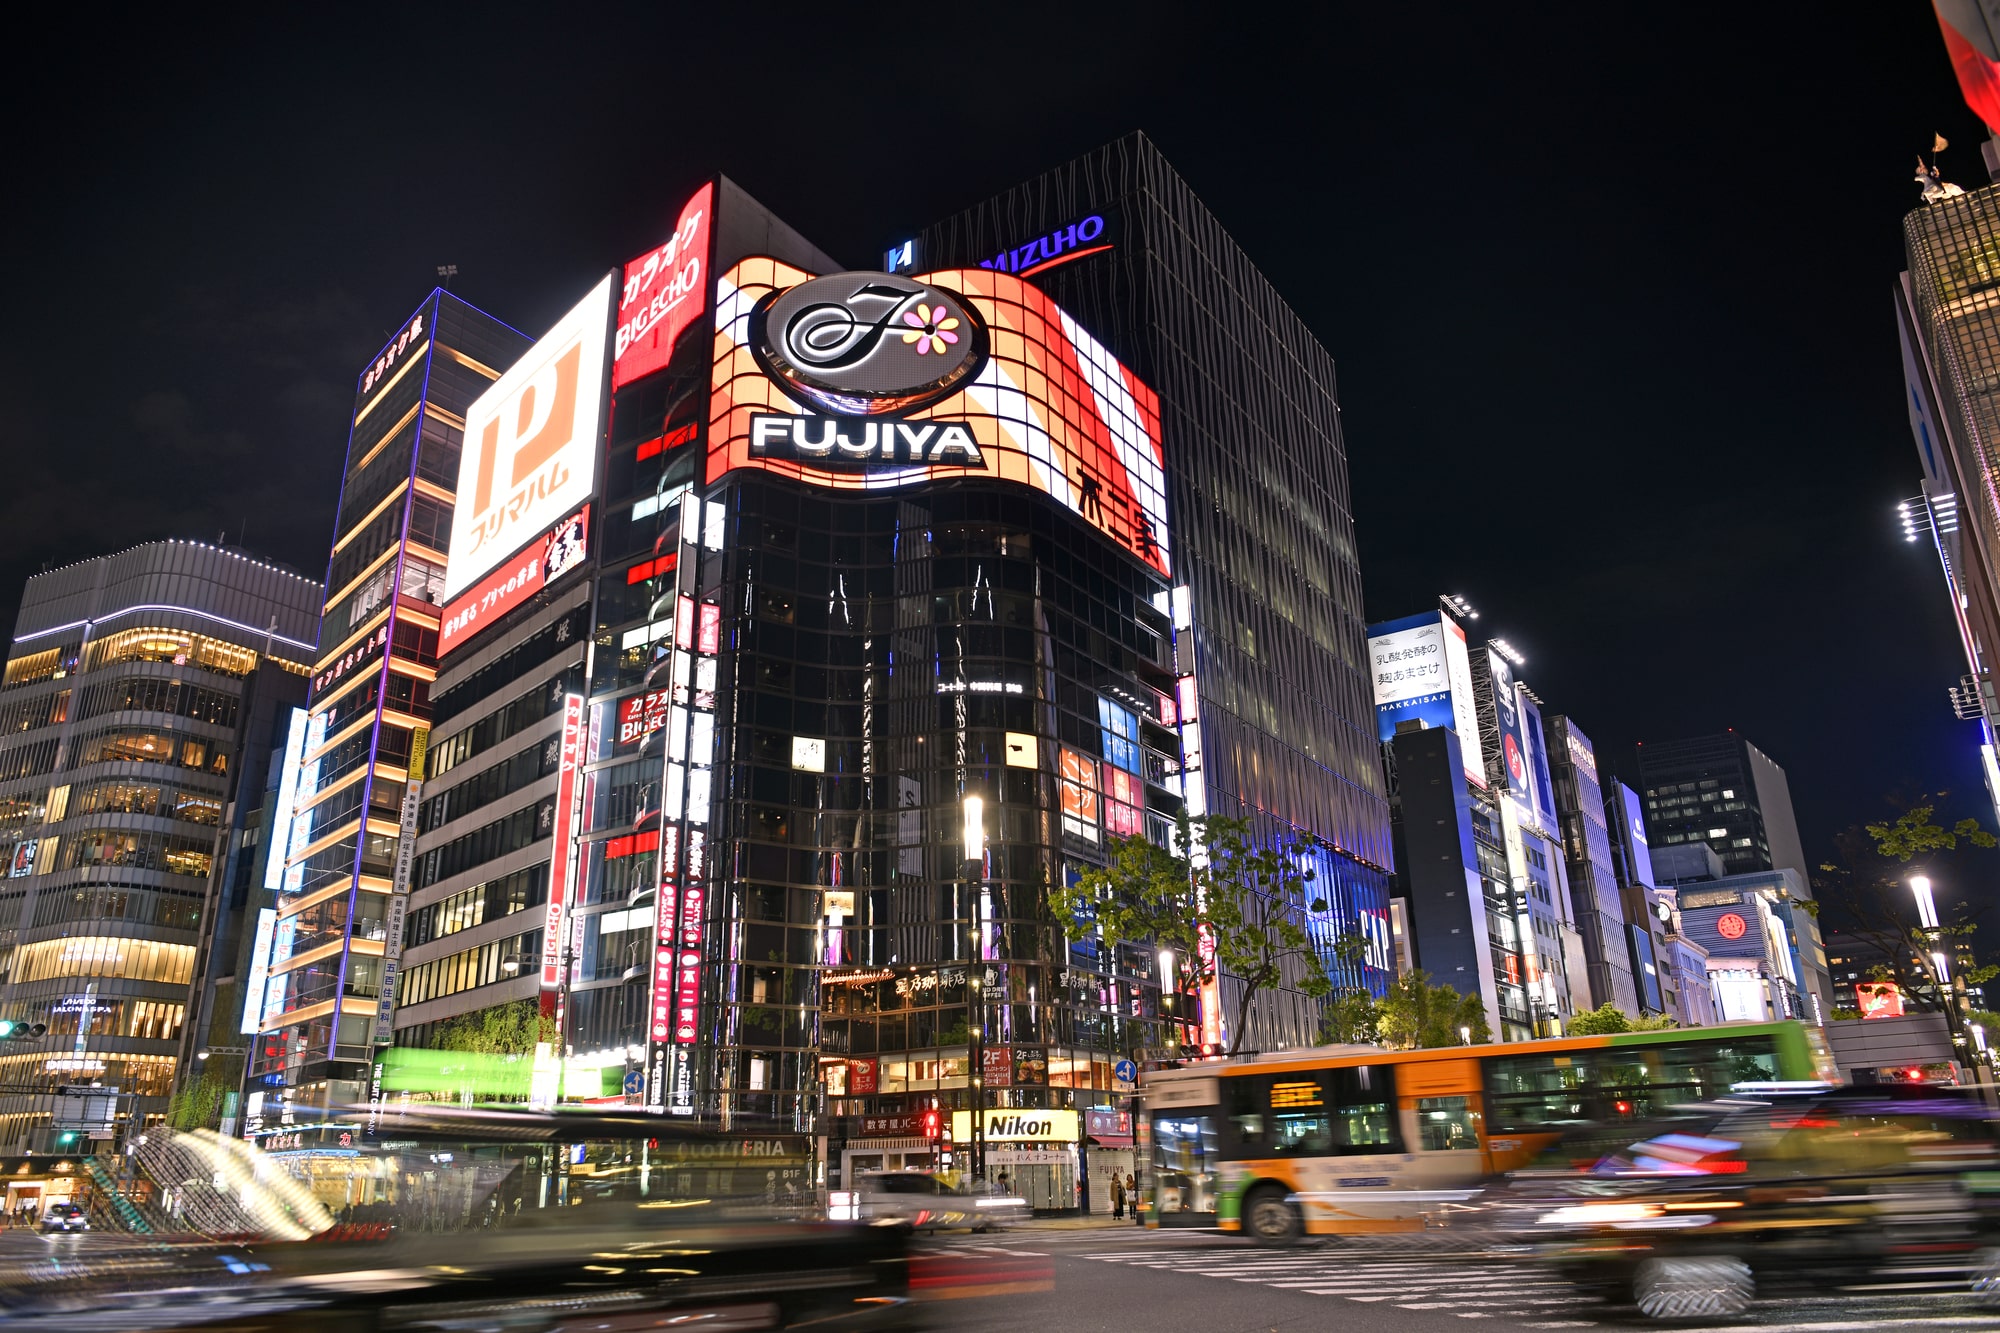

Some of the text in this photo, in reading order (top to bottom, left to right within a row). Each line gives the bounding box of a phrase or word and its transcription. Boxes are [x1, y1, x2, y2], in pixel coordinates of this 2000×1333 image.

[979, 215, 1104, 273] MIZUHO
[622, 210, 703, 311] カラオケ
[615, 257, 700, 361] BIG ECHO
[752, 417, 982, 460] FUJIYA
[469, 461, 569, 555] プリマハム
[1076, 466, 1158, 565] 不二家
[1375, 643, 1438, 666] 乳酸発酵の
[1377, 662, 1441, 685] 麹あまさけ
[631, 689, 668, 713] カラオ
[1380, 693, 1446, 712] HAKKAISAN
[650, 713, 666, 730] EC
[412, 731, 421, 768] BREITLING
[562, 705, 580, 773] カラオケ
[1360, 910, 1390, 972] GAP
[379, 963, 396, 1023] 五百住歯科
[656, 967, 669, 1020] 不二家
[895, 970, 967, 995] 星乃珈琲店
[1060, 971, 1104, 994] 星乃珈琲店
[1779, 979, 1791, 1017] MITSUKOSHI
[1811, 994, 1823, 1027] MITSUKOSHI
[983, 1049, 1000, 1065] 2F
[1016, 1049, 1027, 1060] 2F
[374, 1063, 383, 1079] THE
[371, 1079, 381, 1097] SUIT
[989, 1115, 1052, 1136] Nikon
[687, 1141, 785, 1157] LOTTERIA
[782, 1169, 801, 1178] B1F
[1100, 1165, 1125, 1174] FUJIYA
